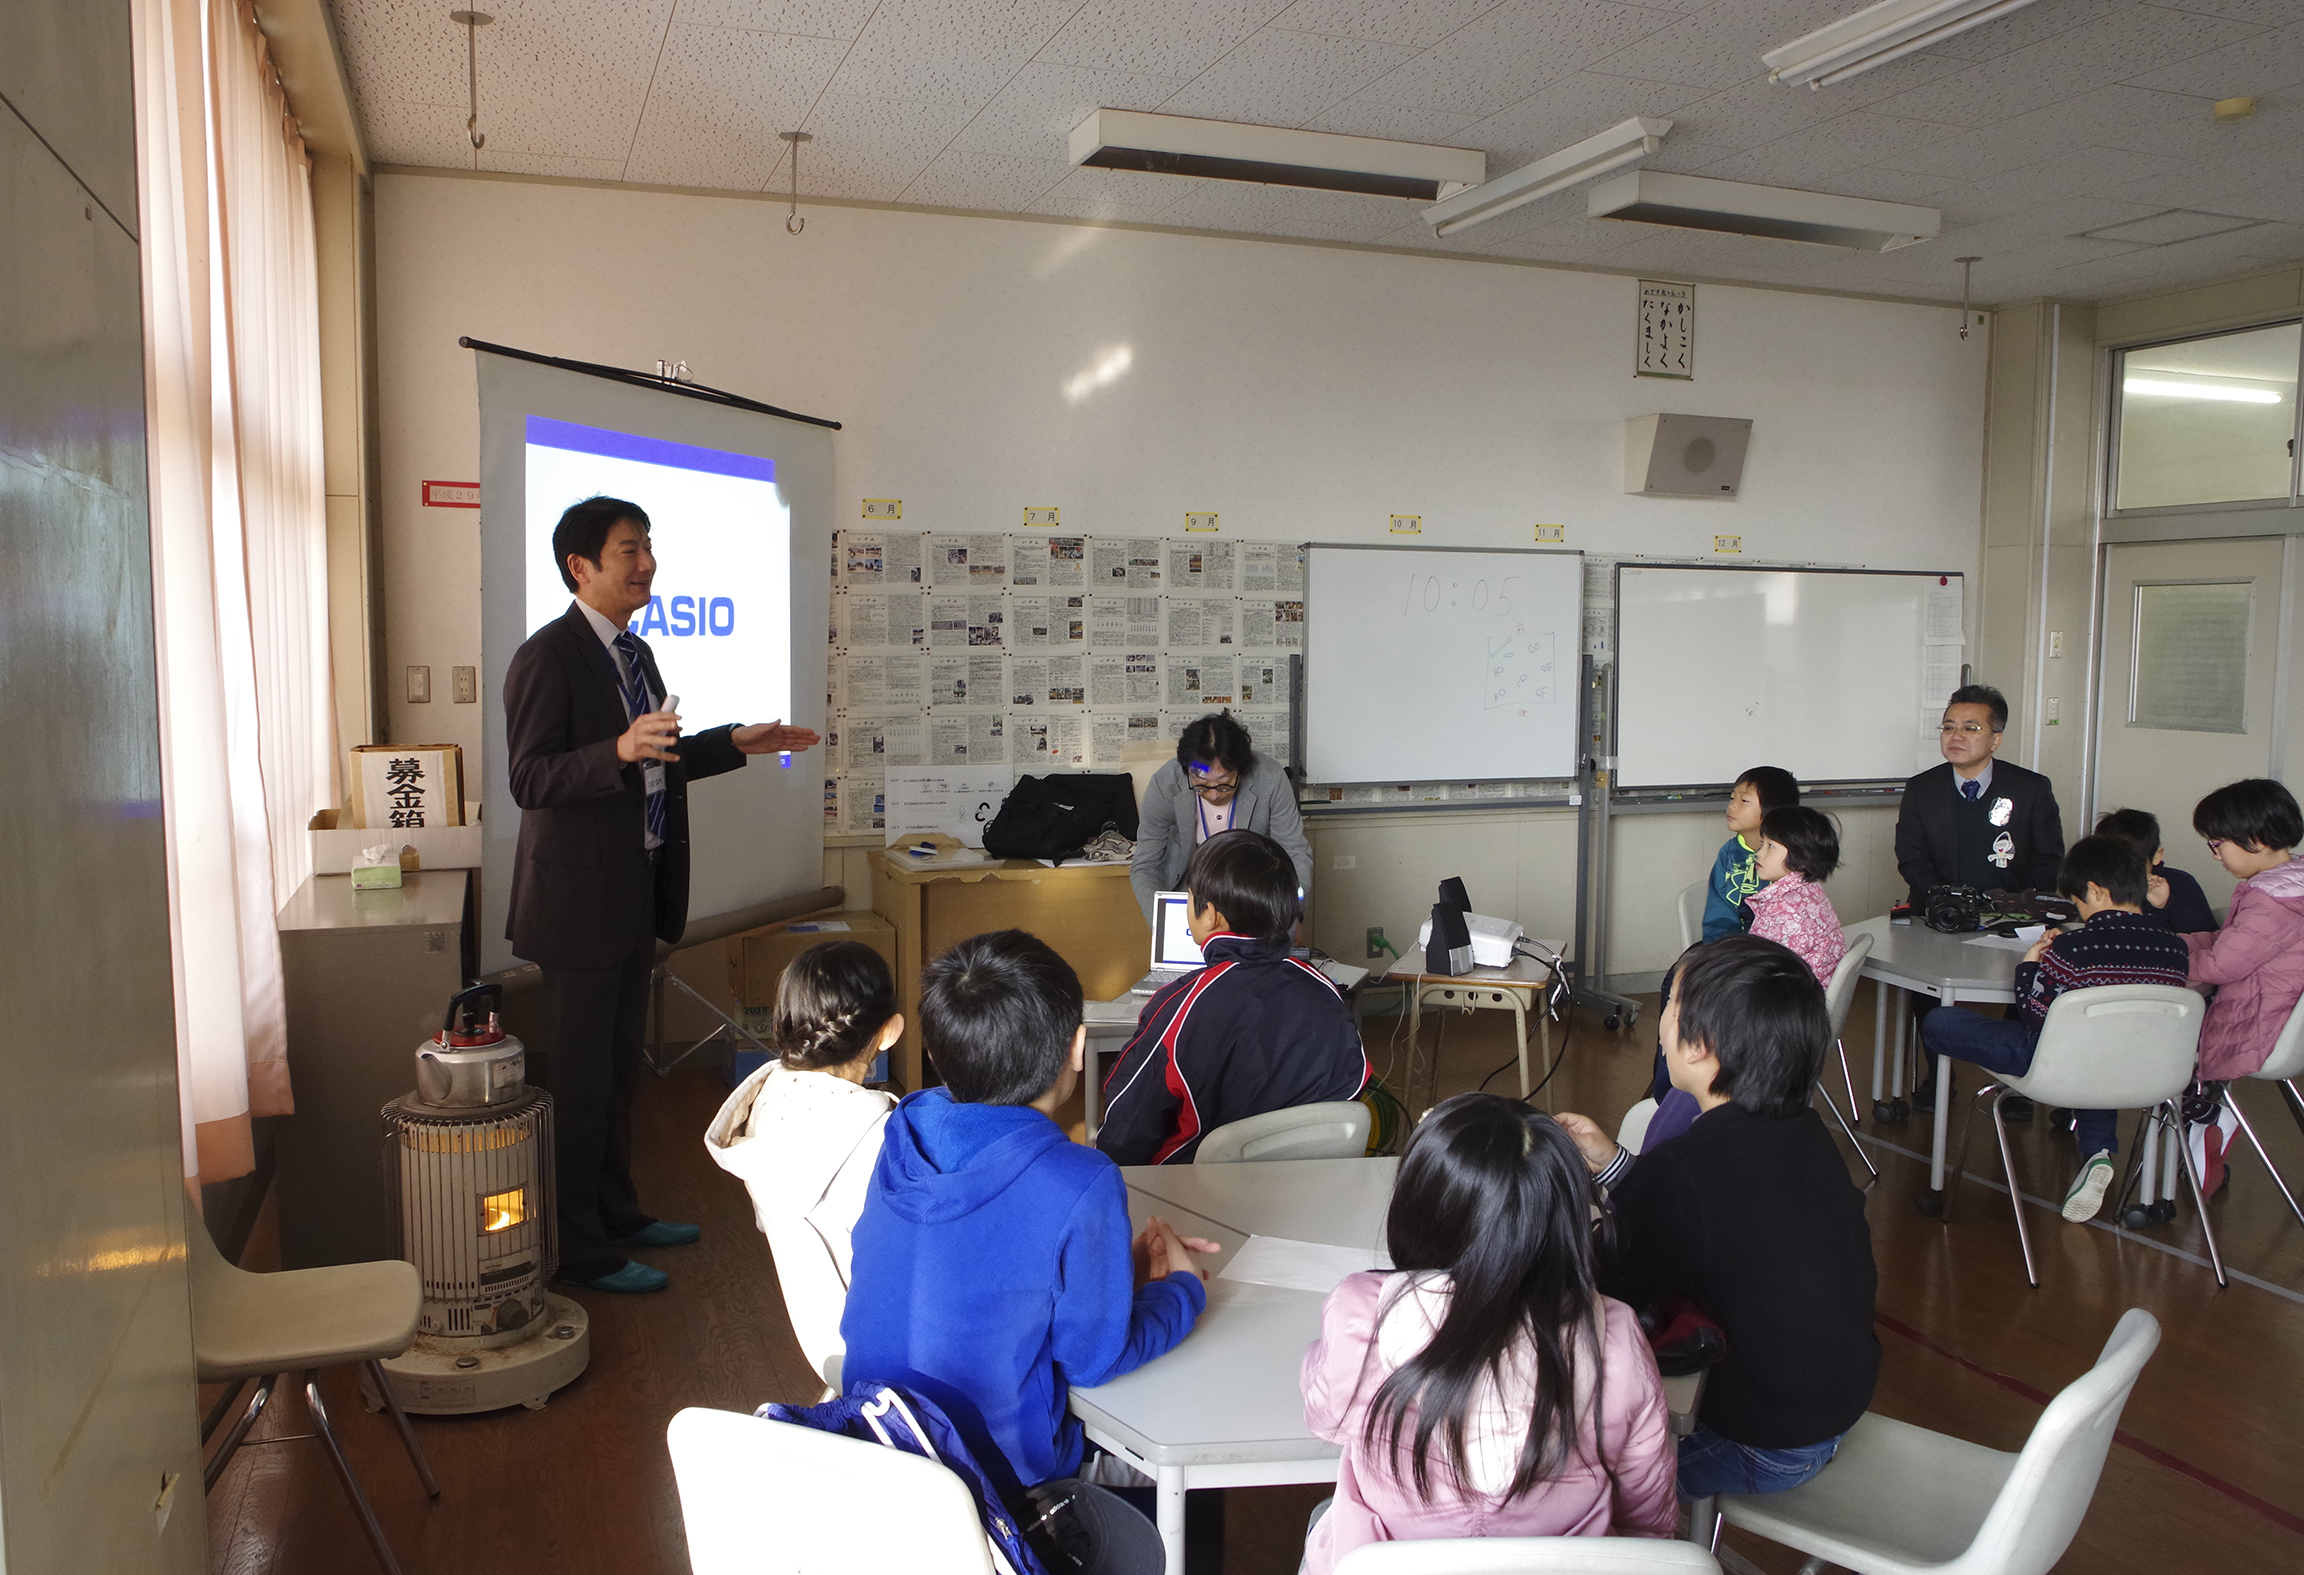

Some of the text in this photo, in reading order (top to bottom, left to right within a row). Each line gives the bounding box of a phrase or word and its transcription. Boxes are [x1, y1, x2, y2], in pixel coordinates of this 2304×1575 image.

[1642, 299, 1654, 368] たくましく
[1660, 301, 1673, 369] なかよく
[1677, 302, 1691, 369] かしこく
[628, 595, 735, 637] ASIO
[1404, 574, 1520, 617] 10:05
[385, 757, 427, 828] 募金箱
[744, 1006, 768, 1015] 2018
